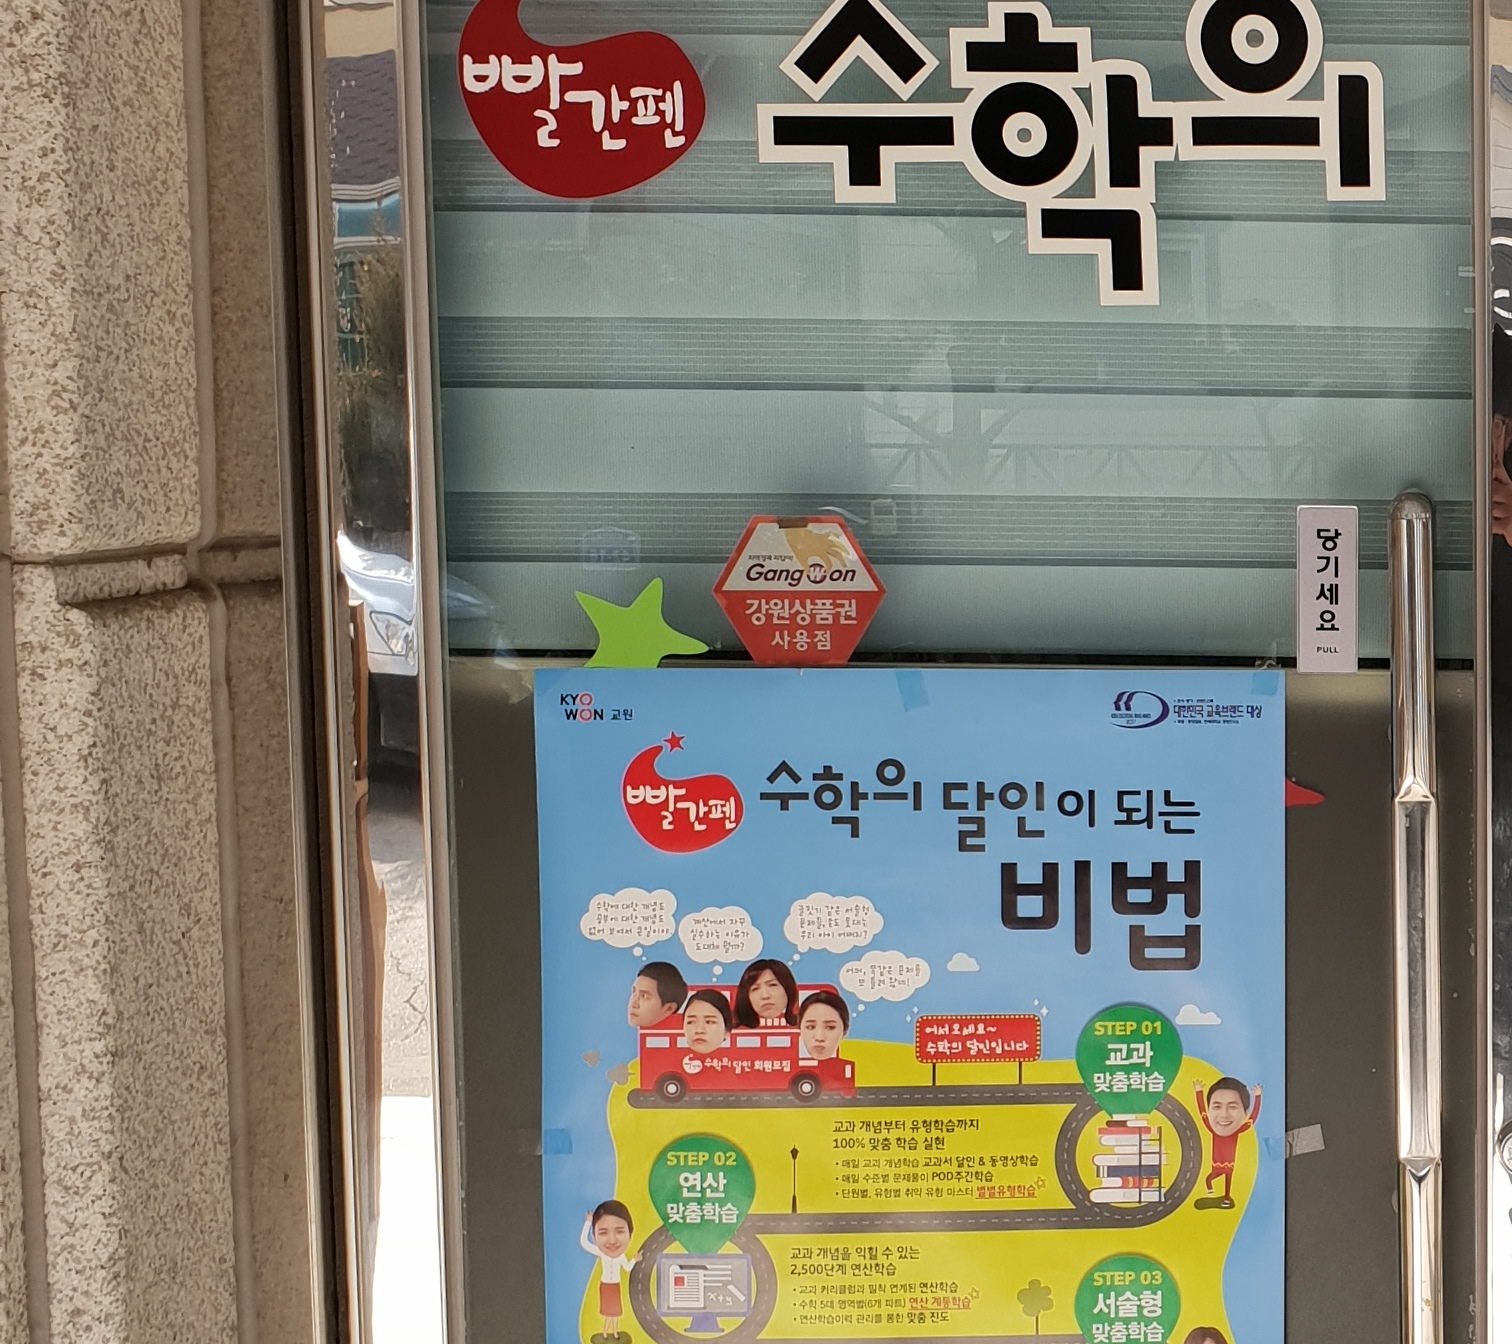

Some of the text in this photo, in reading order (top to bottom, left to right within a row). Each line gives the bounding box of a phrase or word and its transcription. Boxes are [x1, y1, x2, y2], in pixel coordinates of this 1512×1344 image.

[460, 52, 687, 151] 빨간펜
[1315, 528, 1343, 632] 당기세요
[744, 598, 858, 626] 강원상품권
[770, 629, 832, 651] 사용점
[1316, 646, 1340, 654] PULL
[559, 692, 594, 707] KYO
[564, 708, 634, 723] WON 교원
[1173, 704, 1263, 719] 대한민국 교육브랜드 대상
[625, 784, 737, 832] 빨간펜
[759, 757, 1201, 853] 수학의 달인이 되는
[1000, 859, 1202, 972] 비법
[1093, 1020, 1163, 1036] STEP 01
[925, 1037, 1030, 1056] 수학의 달인입니다
[1104, 1040, 1154, 1068] 교과
[704, 1057, 731, 1072] 수학의
[732, 1060, 752, 1074] 달인
[753, 1059, 791, 1073] 회원모집
[1092, 1071, 1166, 1094] 맞춤학습
[832, 1118, 980, 1134] 교과 개념부터 유형학습까지
[832, 1136, 946, 1151] 100% 맞춤 학습 실현
[666, 1151, 737, 1166] STEP 02
[921, 1154, 1039, 1168] 교과서 달인 동영상학습
[678, 1171, 728, 1199] 연산
[931, 1170, 994, 1183] POD주간학습
[666, 1202, 740, 1225] 맞춤학습
[789, 1245, 921, 1261] 교과 개념을 익힐 수 있는
[789, 1262, 897, 1277] 2,500단계 연산학습
[1092, 1270, 1163, 1287] STEP 03
[918, 1281, 959, 1294] 연산학습
[1092, 1289, 1163, 1318] 서술형
[1091, 1321, 1165, 1344] 맞춤학습
